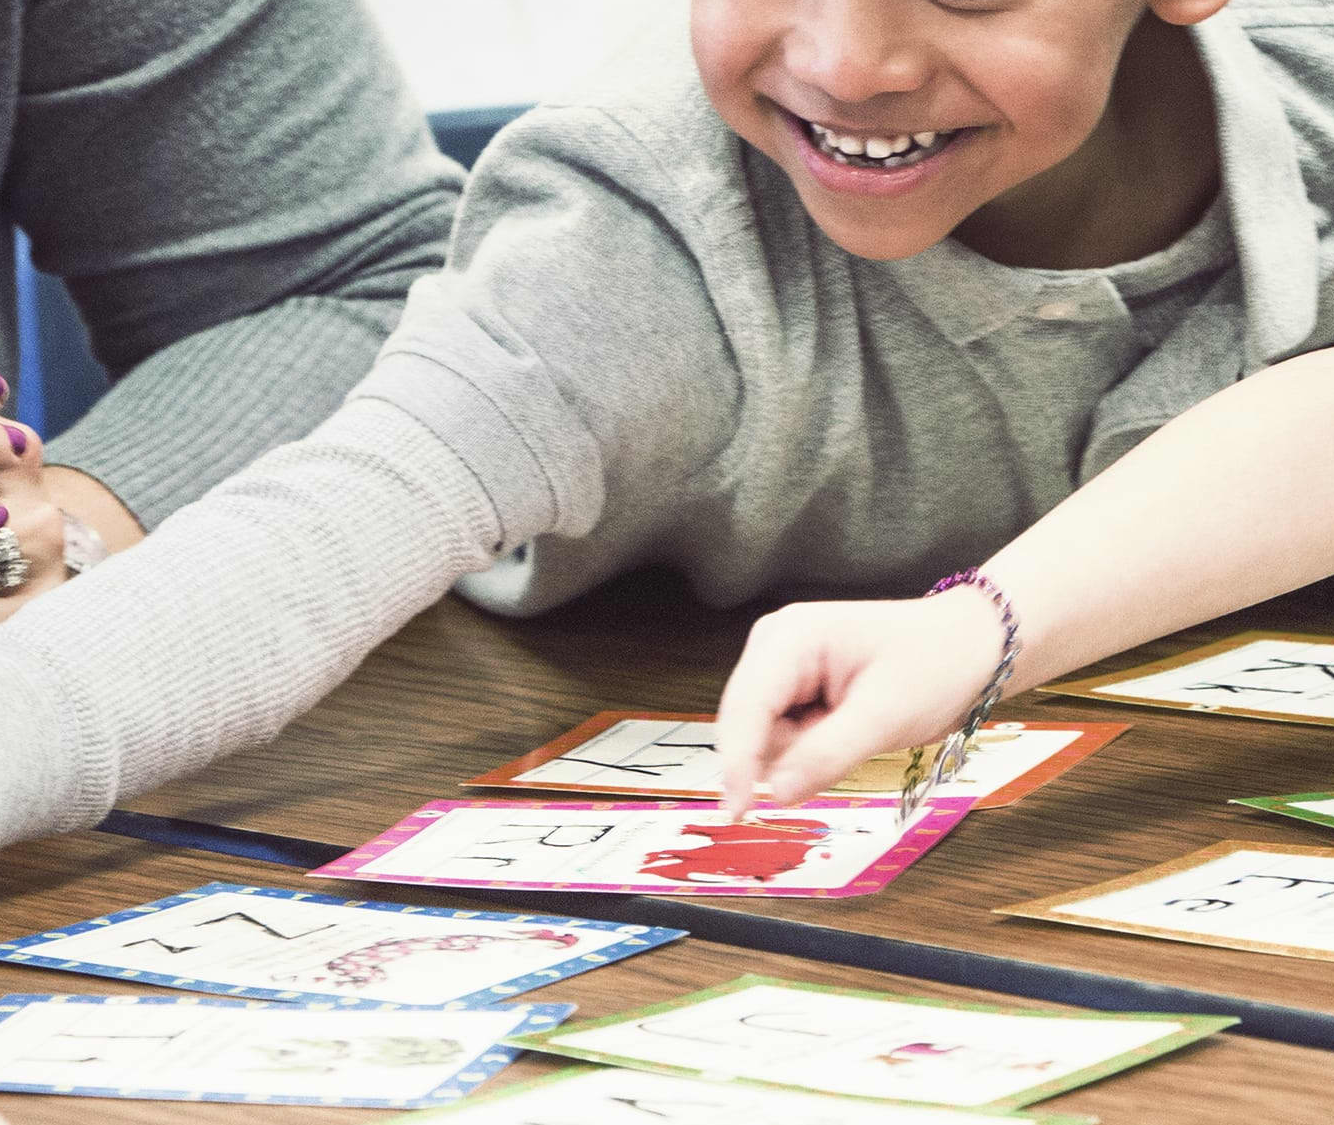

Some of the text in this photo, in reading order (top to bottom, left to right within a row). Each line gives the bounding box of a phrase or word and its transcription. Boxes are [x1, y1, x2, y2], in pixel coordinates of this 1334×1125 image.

[1182, 682, 1305, 695] k
[475, 823, 615, 848] R
[1164, 897, 1235, 913] e
[122, 912, 337, 953] Z z
